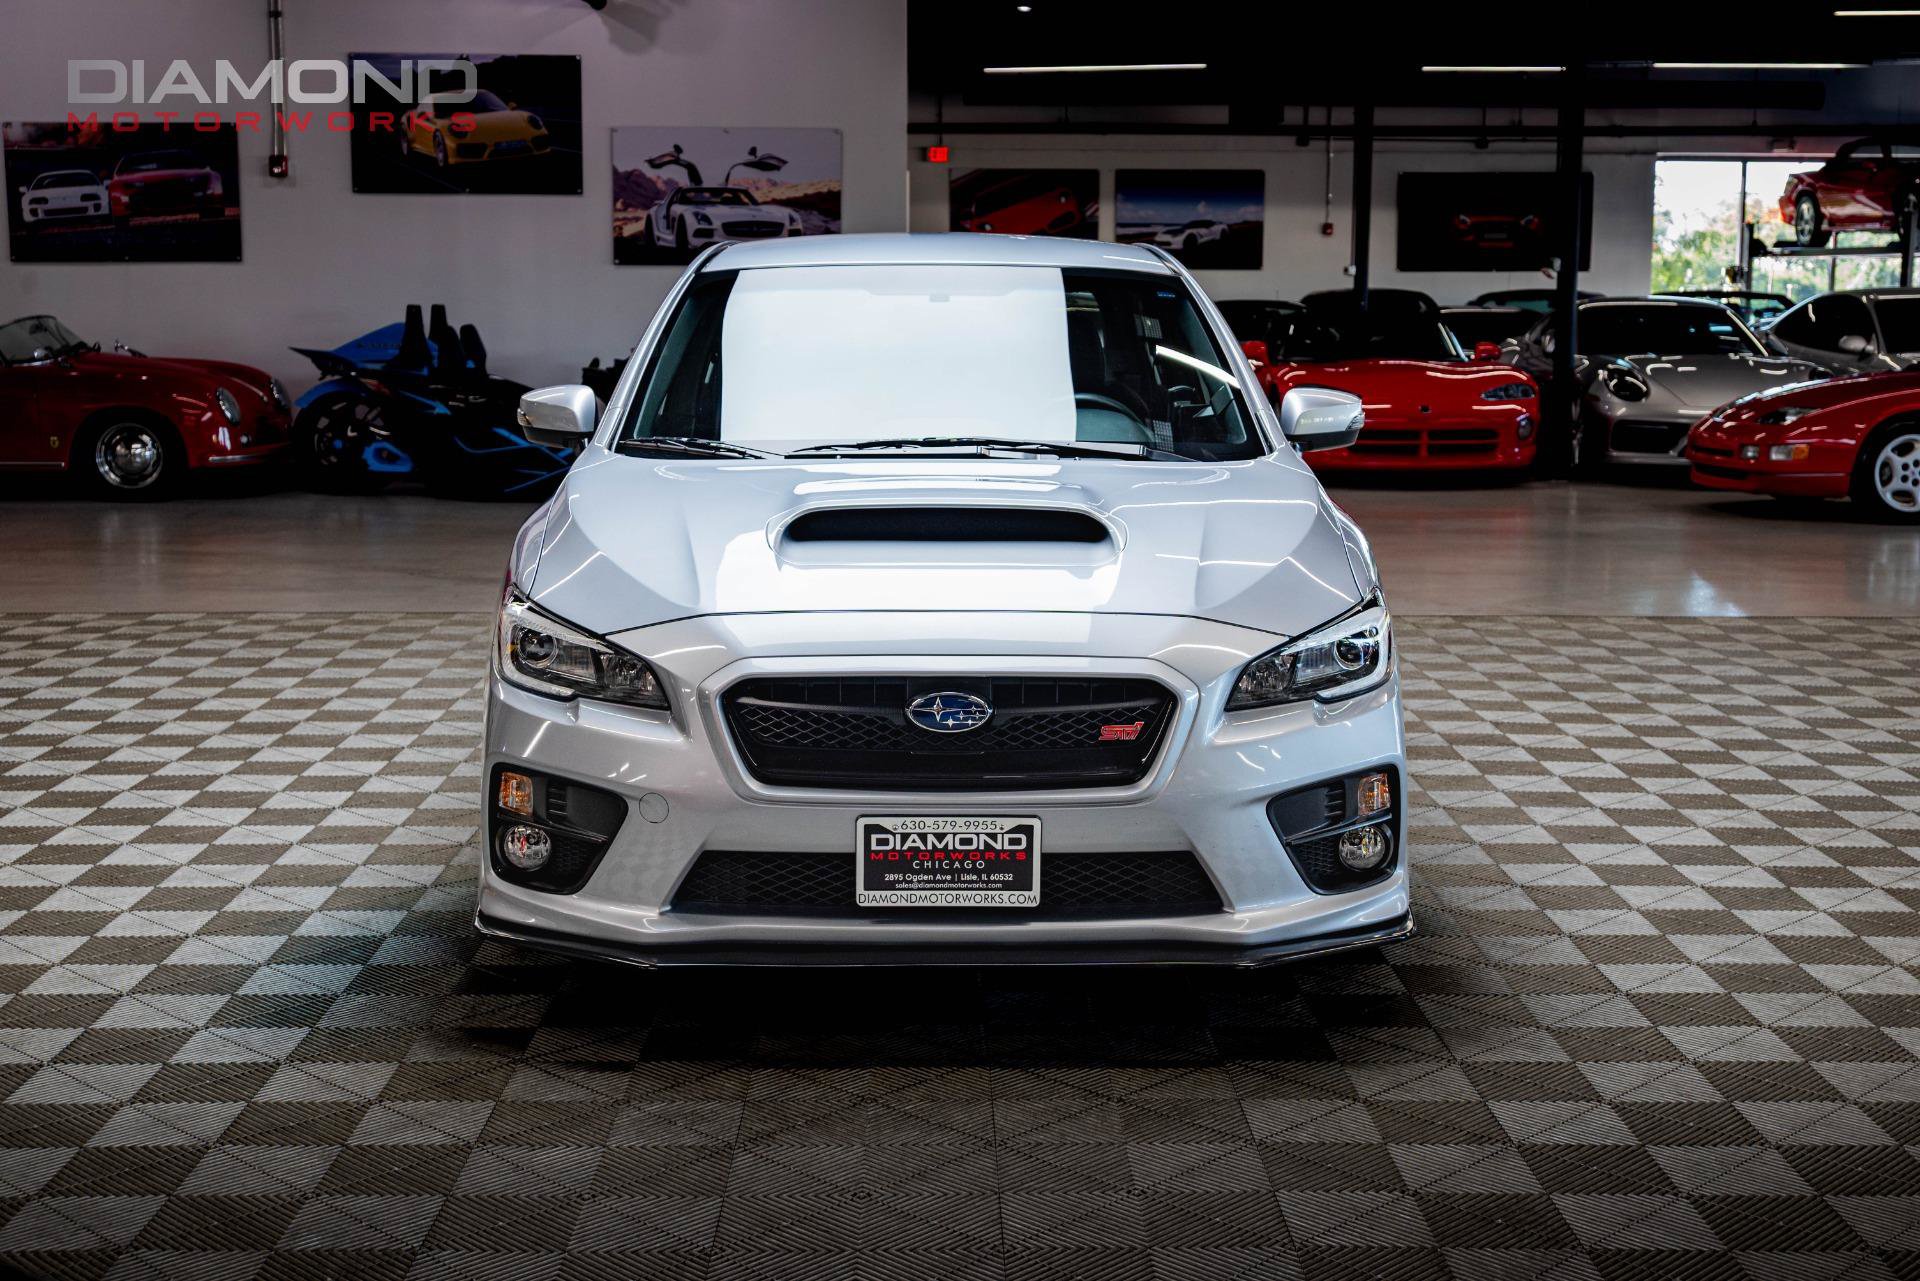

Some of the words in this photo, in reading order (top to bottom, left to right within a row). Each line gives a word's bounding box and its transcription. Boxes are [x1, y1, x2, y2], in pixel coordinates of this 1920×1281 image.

[901, 820, 998, 831] 630-579-9955
[870, 833, 1027, 850] DIAMOND
[869, 851, 1027, 861] MOTORWORKS
[912, 860, 986, 869] CHICAGO
[884, 873, 904, 882] 2895
[905, 873, 934, 883] Ogden
[935, 873, 952, 882] Ave
[981, 873, 988, 882] IL
[989, 873, 1013, 882] 60532
[895, 881, 1003, 890] sales@diamondmotorworks.com
[858, 893, 1038, 905] DIAMONDMOTORWORKS.COM
